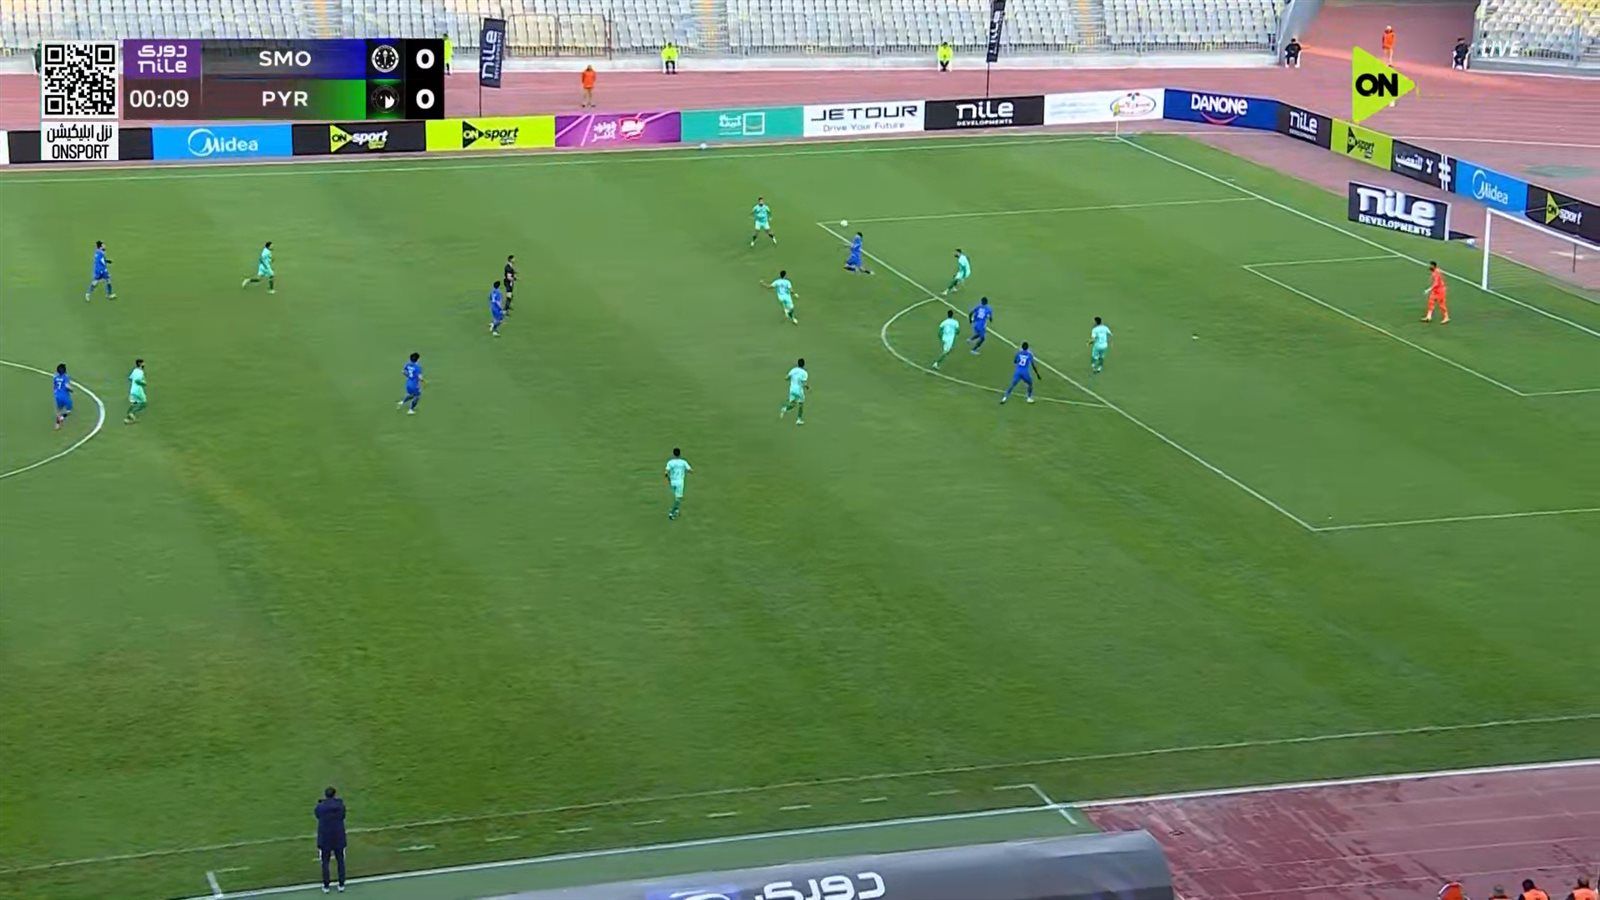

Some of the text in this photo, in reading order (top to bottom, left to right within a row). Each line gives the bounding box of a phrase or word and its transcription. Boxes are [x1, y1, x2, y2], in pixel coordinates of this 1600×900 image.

[811, 105, 918, 122] JETOUR
[463, 130, 479, 140] ON
[484, 127, 519, 142] sport
[823, 121, 905, 132] Drive Your Future
[331, 134, 347, 143] ON
[351, 130, 389, 146] sport
[1558, 208, 1582, 225] sport
[1358, 214, 1432, 237] DEVELOPMENTS
